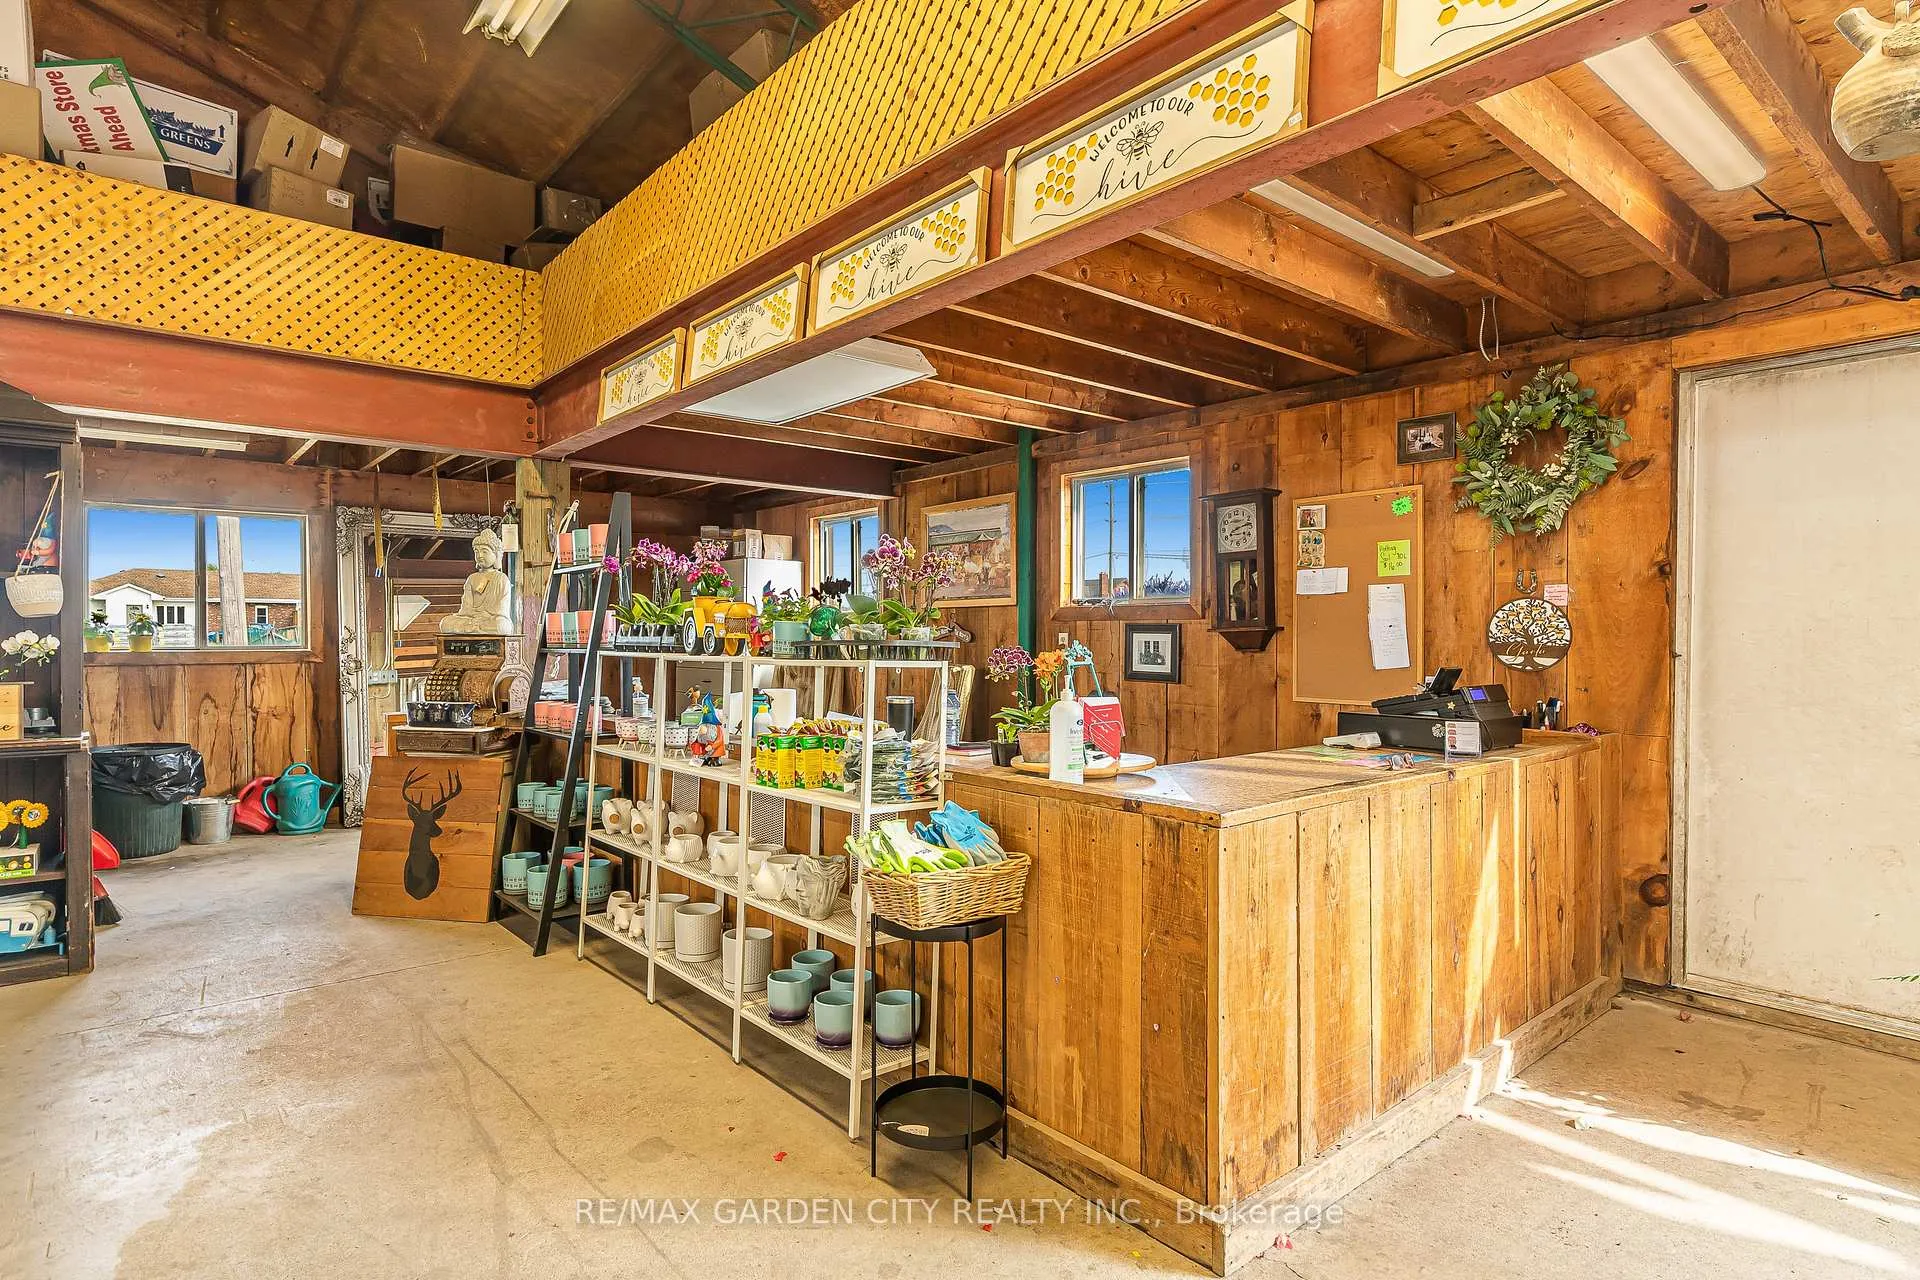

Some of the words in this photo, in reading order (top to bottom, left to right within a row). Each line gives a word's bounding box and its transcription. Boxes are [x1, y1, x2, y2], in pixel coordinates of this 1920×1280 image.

[46, 70, 81, 113] Store
[93, 105, 136, 152] Ahead
[160, 126, 211, 151] GREENS
[1089, 104, 1147, 163] WELCOME
[1149, 97, 1166, 113] TO
[1167, 96, 1196, 118] OUR
[1096, 148, 1180, 201] hive
[863, 231, 897, 270] WELCOME
[899, 226, 909, 237] TO
[909, 226, 926, 243] OUR
